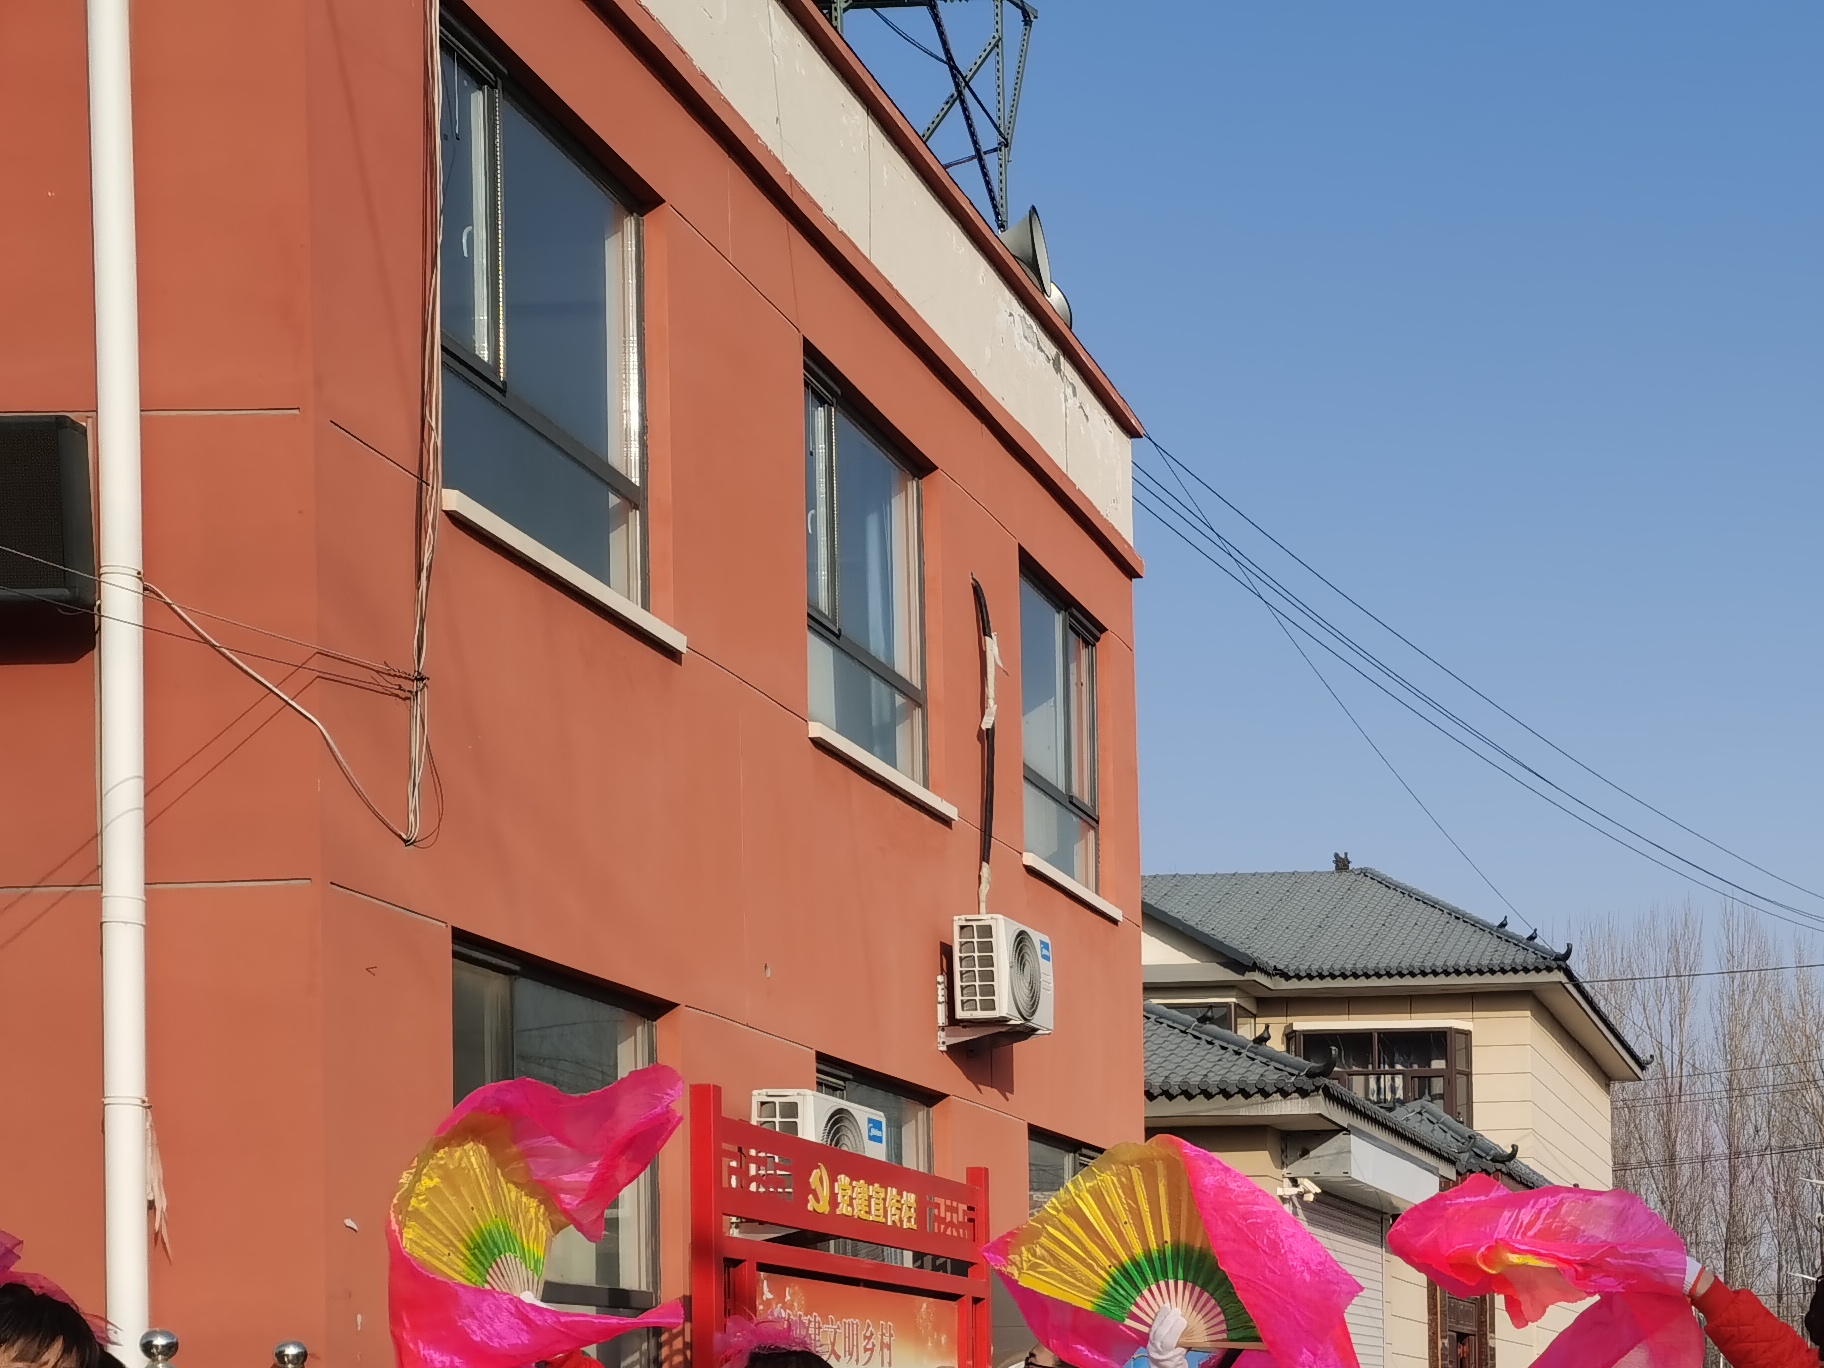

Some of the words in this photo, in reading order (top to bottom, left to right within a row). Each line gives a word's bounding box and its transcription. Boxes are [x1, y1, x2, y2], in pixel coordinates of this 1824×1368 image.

[834, 1174, 917, 1230] 党建宣传栏
